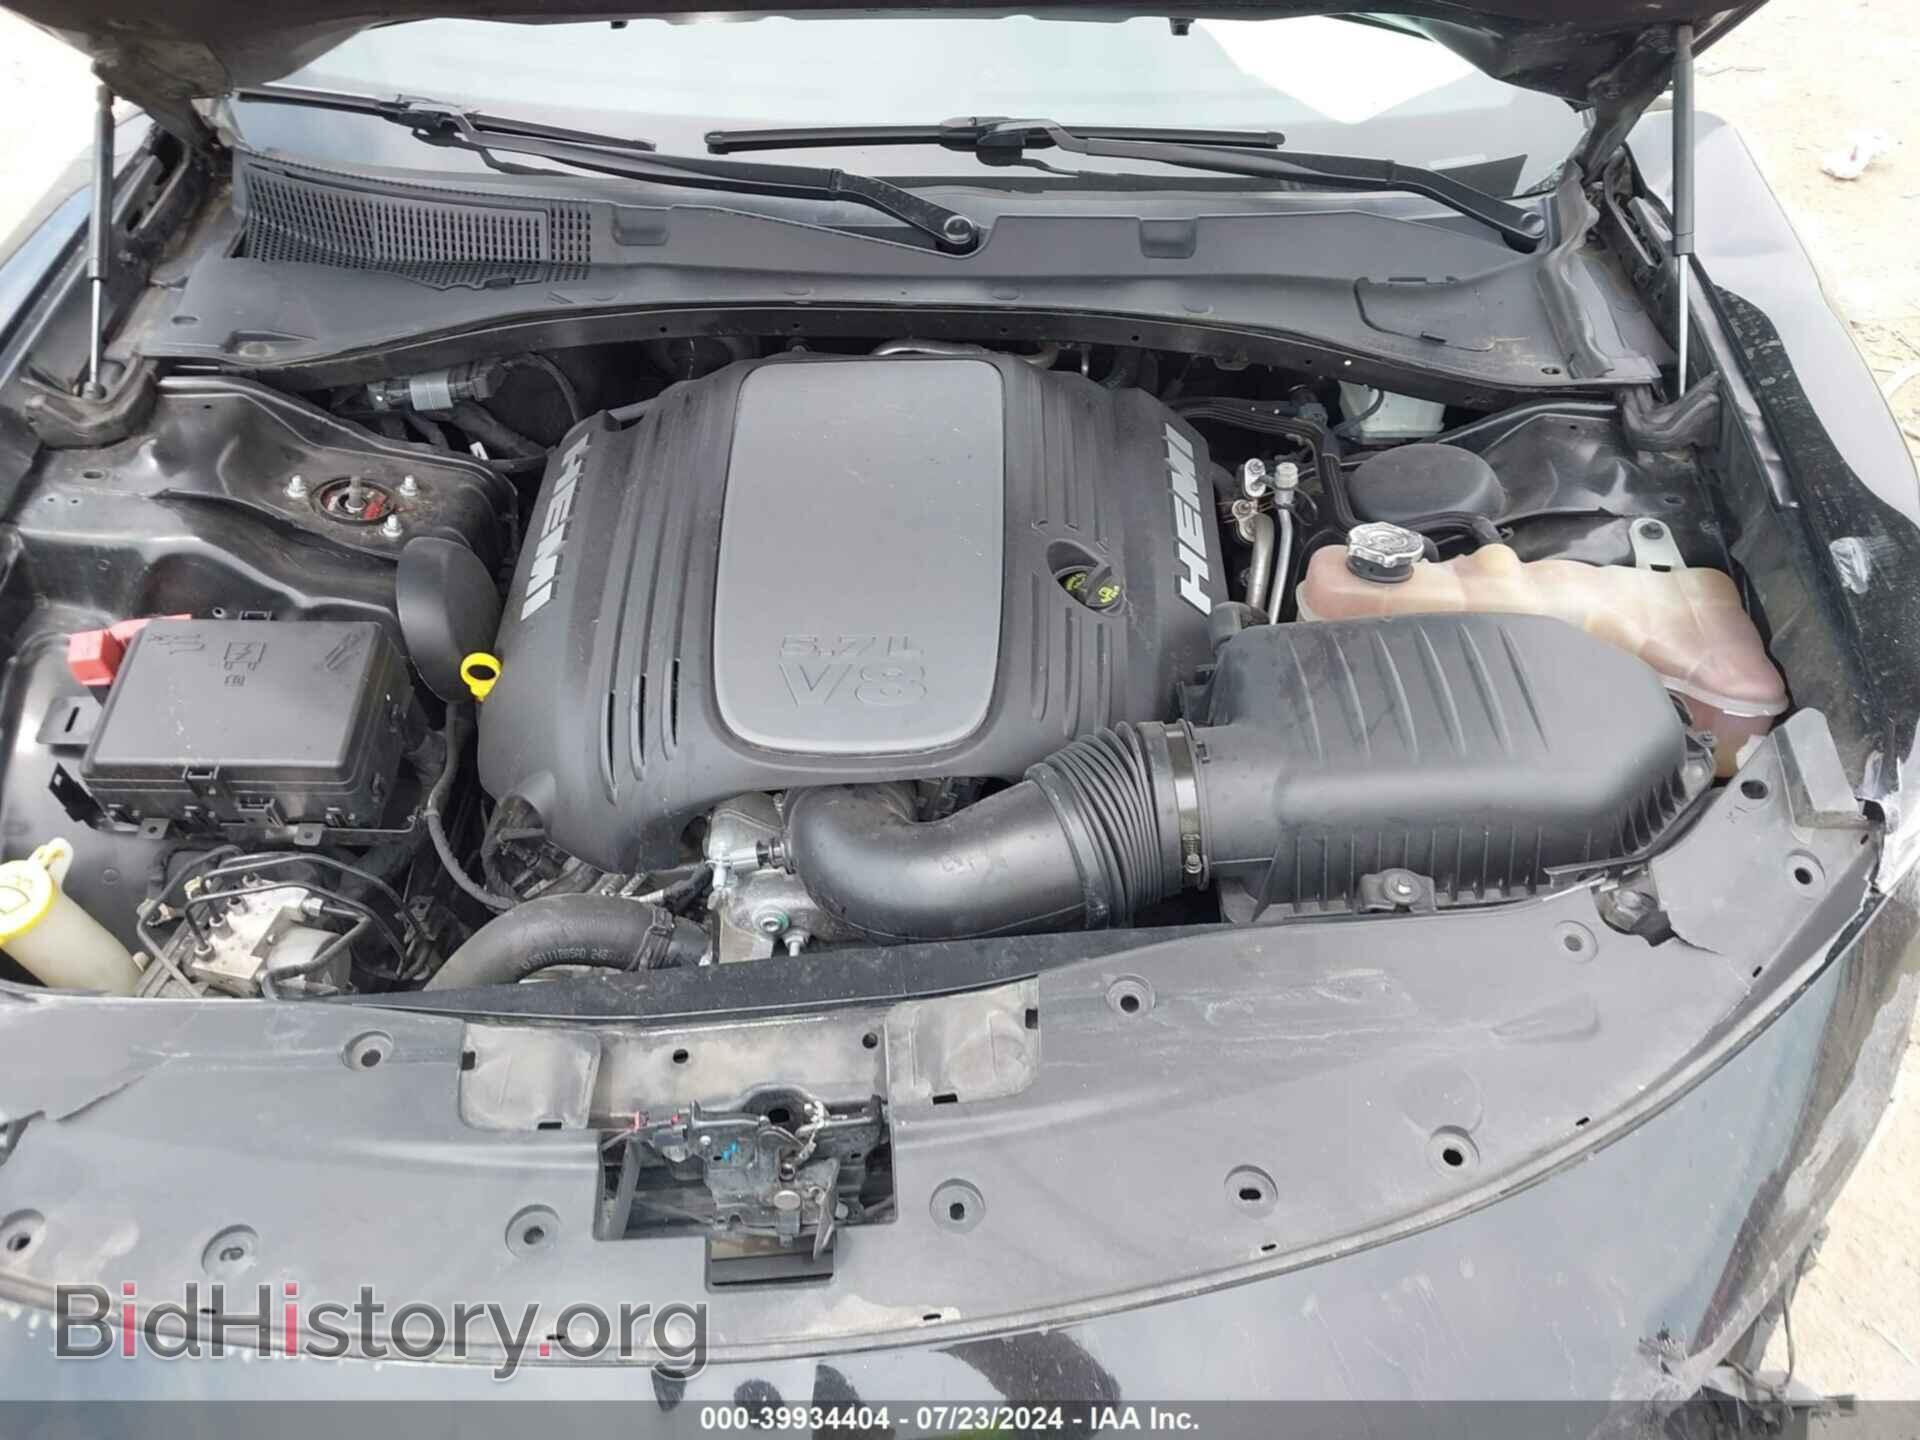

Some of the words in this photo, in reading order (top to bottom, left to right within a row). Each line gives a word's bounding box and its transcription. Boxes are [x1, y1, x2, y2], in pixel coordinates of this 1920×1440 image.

[520, 433, 590, 621] HEMI
[1164, 423, 1212, 616] HEMI
[778, 664, 928, 706] V8
[779, 634, 925, 657] 5.7L
